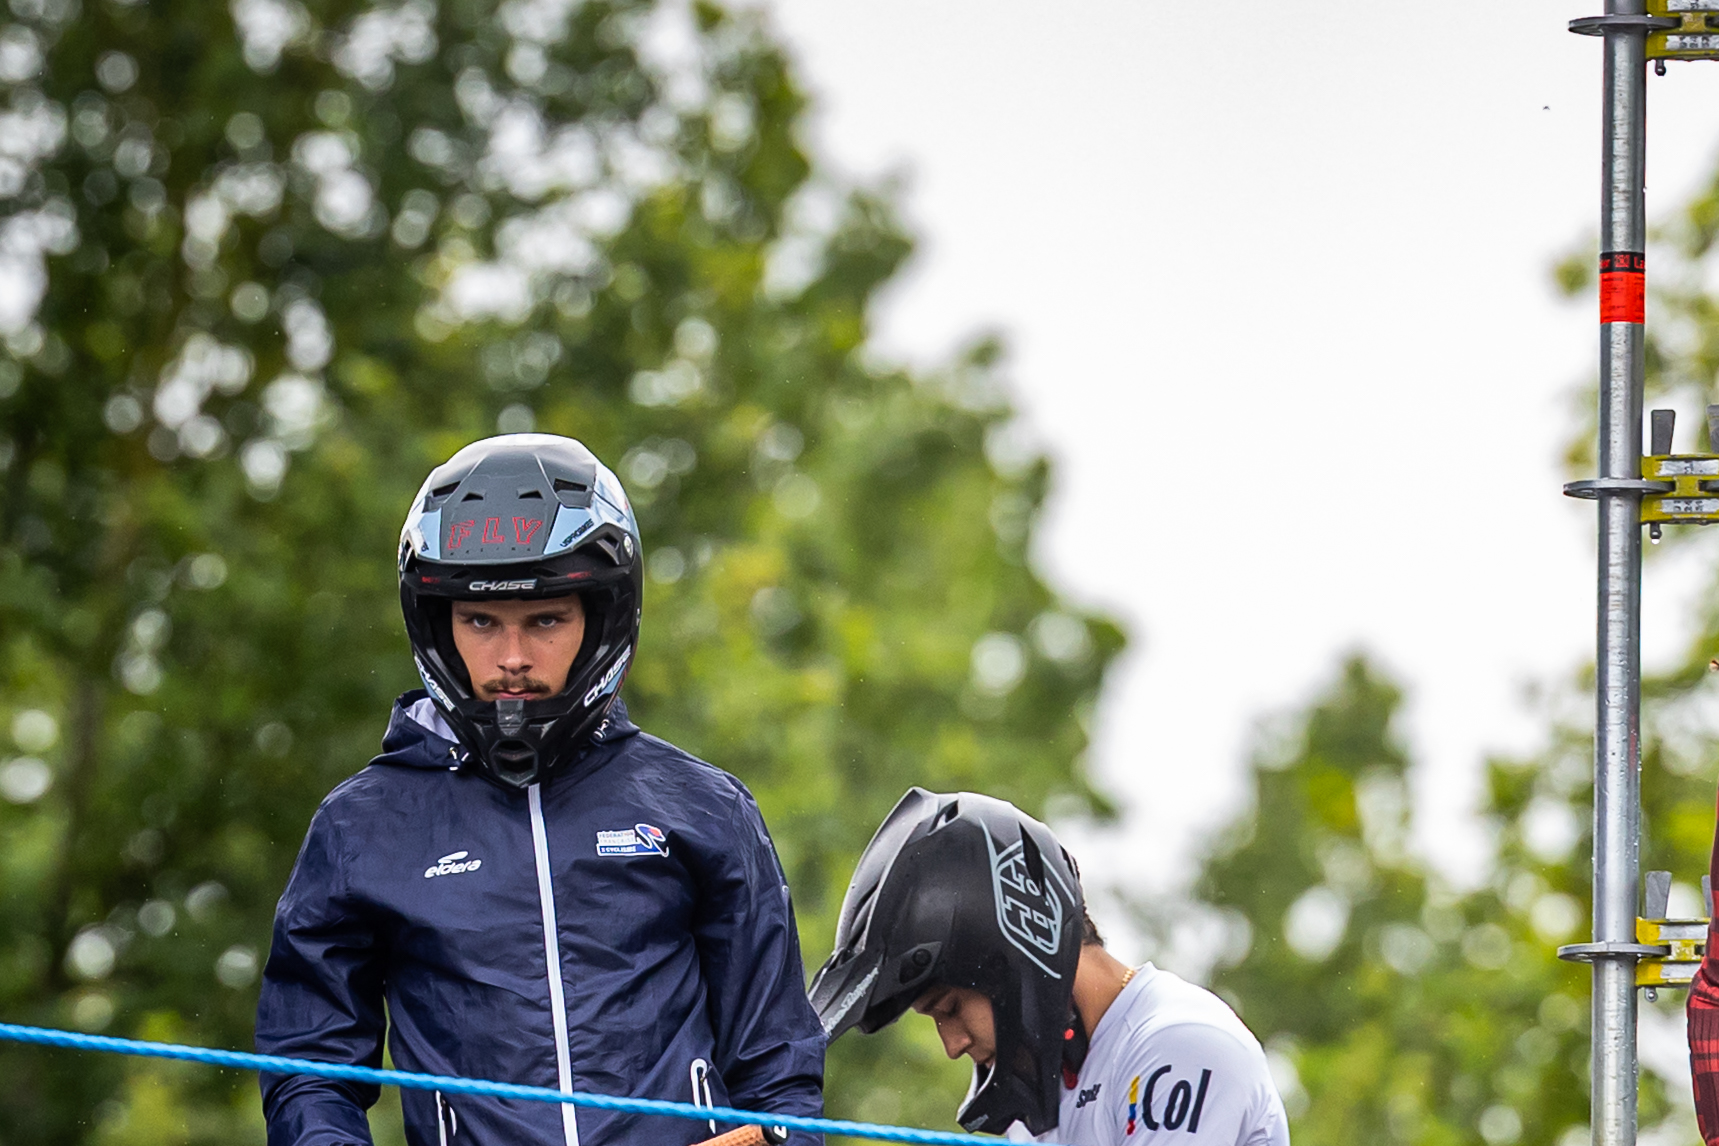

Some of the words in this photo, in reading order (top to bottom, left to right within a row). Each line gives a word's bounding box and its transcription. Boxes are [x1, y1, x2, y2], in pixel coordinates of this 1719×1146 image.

[448, 516, 543, 549] FLY
[469, 578, 537, 592] CHASE
[583, 643, 631, 708] CHASE
[1142, 1064, 1212, 1133] Col
